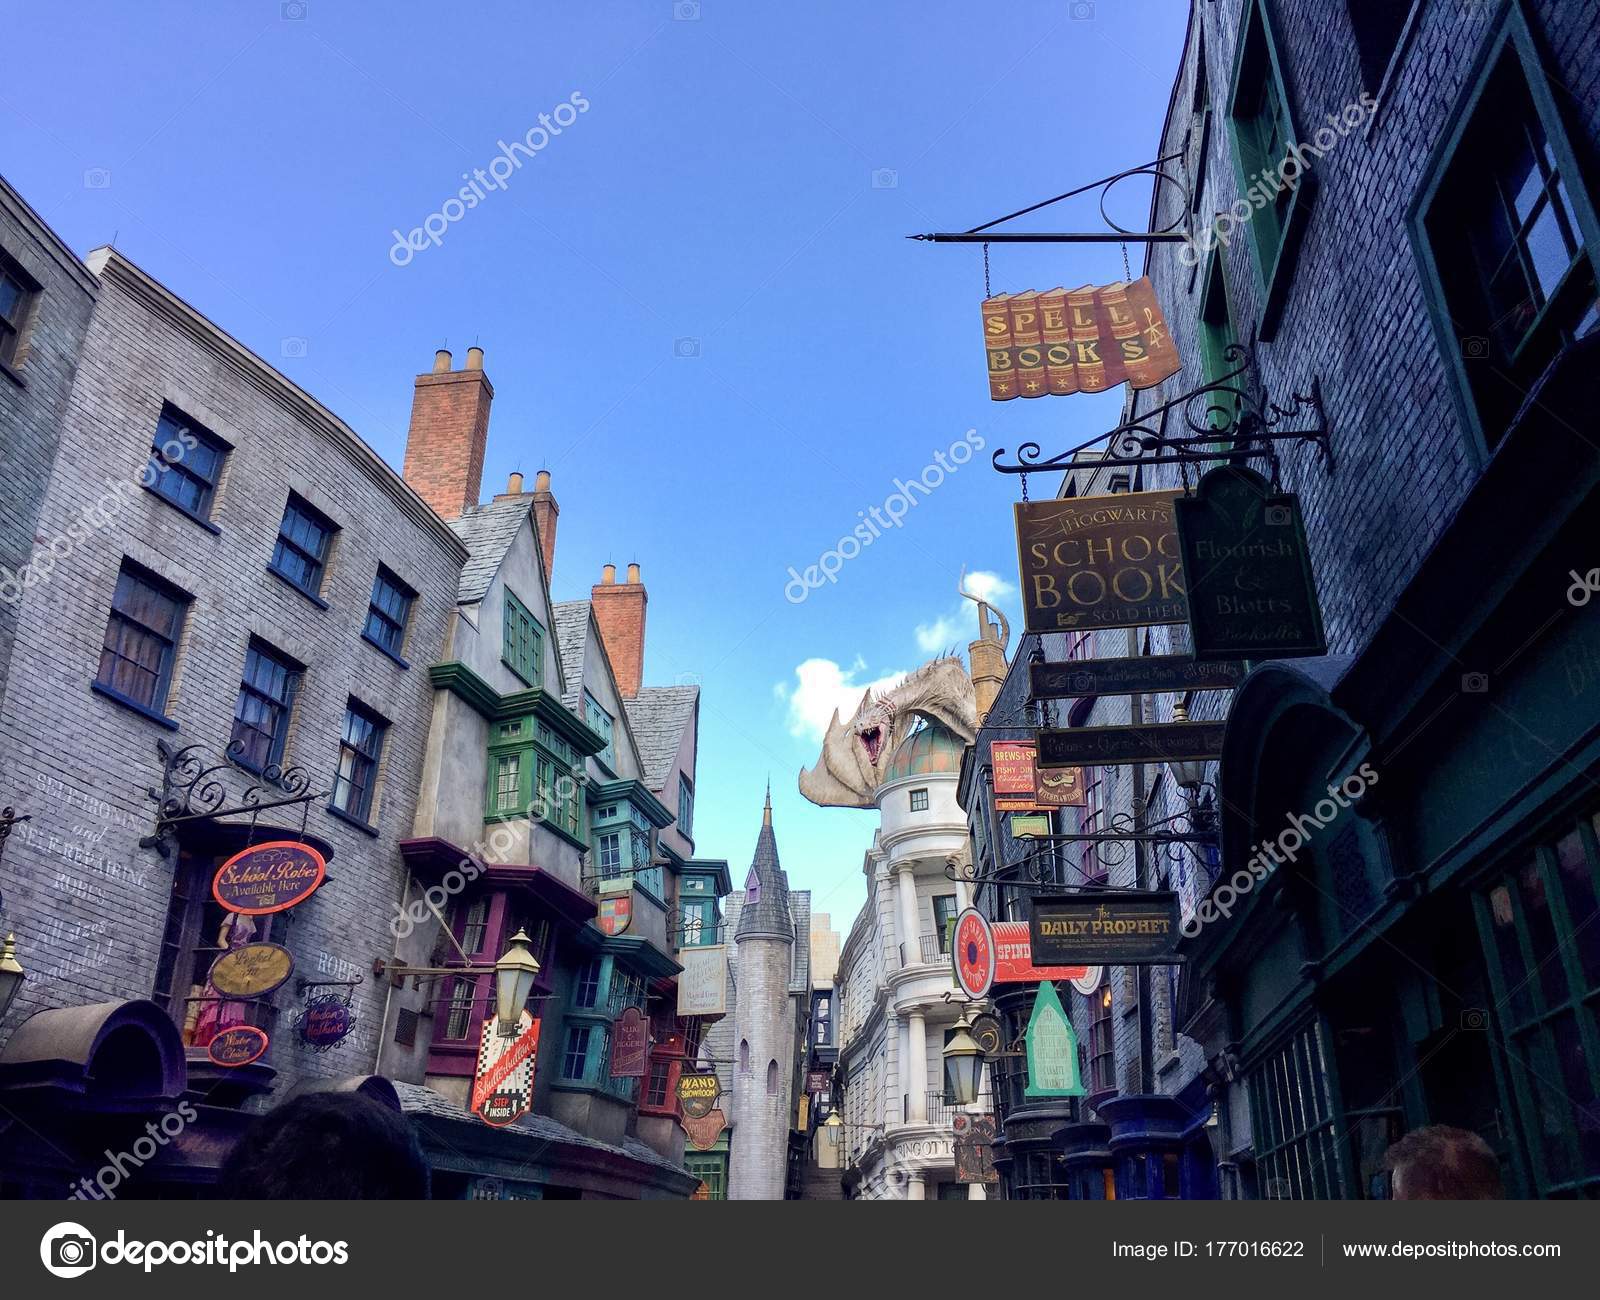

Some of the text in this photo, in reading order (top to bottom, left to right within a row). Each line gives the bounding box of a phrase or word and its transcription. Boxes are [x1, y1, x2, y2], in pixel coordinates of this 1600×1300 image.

[986, 306, 1130, 334] SPELL
[990, 340, 1144, 370] BOOKS
[1061, 507, 1169, 535] HOGWARTS
[994, 750, 1020, 761] BREWS
[220, 860, 319, 885] School Robes
[1039, 919, 1170, 936] DAILY PROPHET
[682, 1077, 716, 1089] WAND
[681, 1089, 715, 1098] SHOWROOM
[494, 1098, 509, 1107] STEP
[489, 1107, 511, 1117] INSIDE
